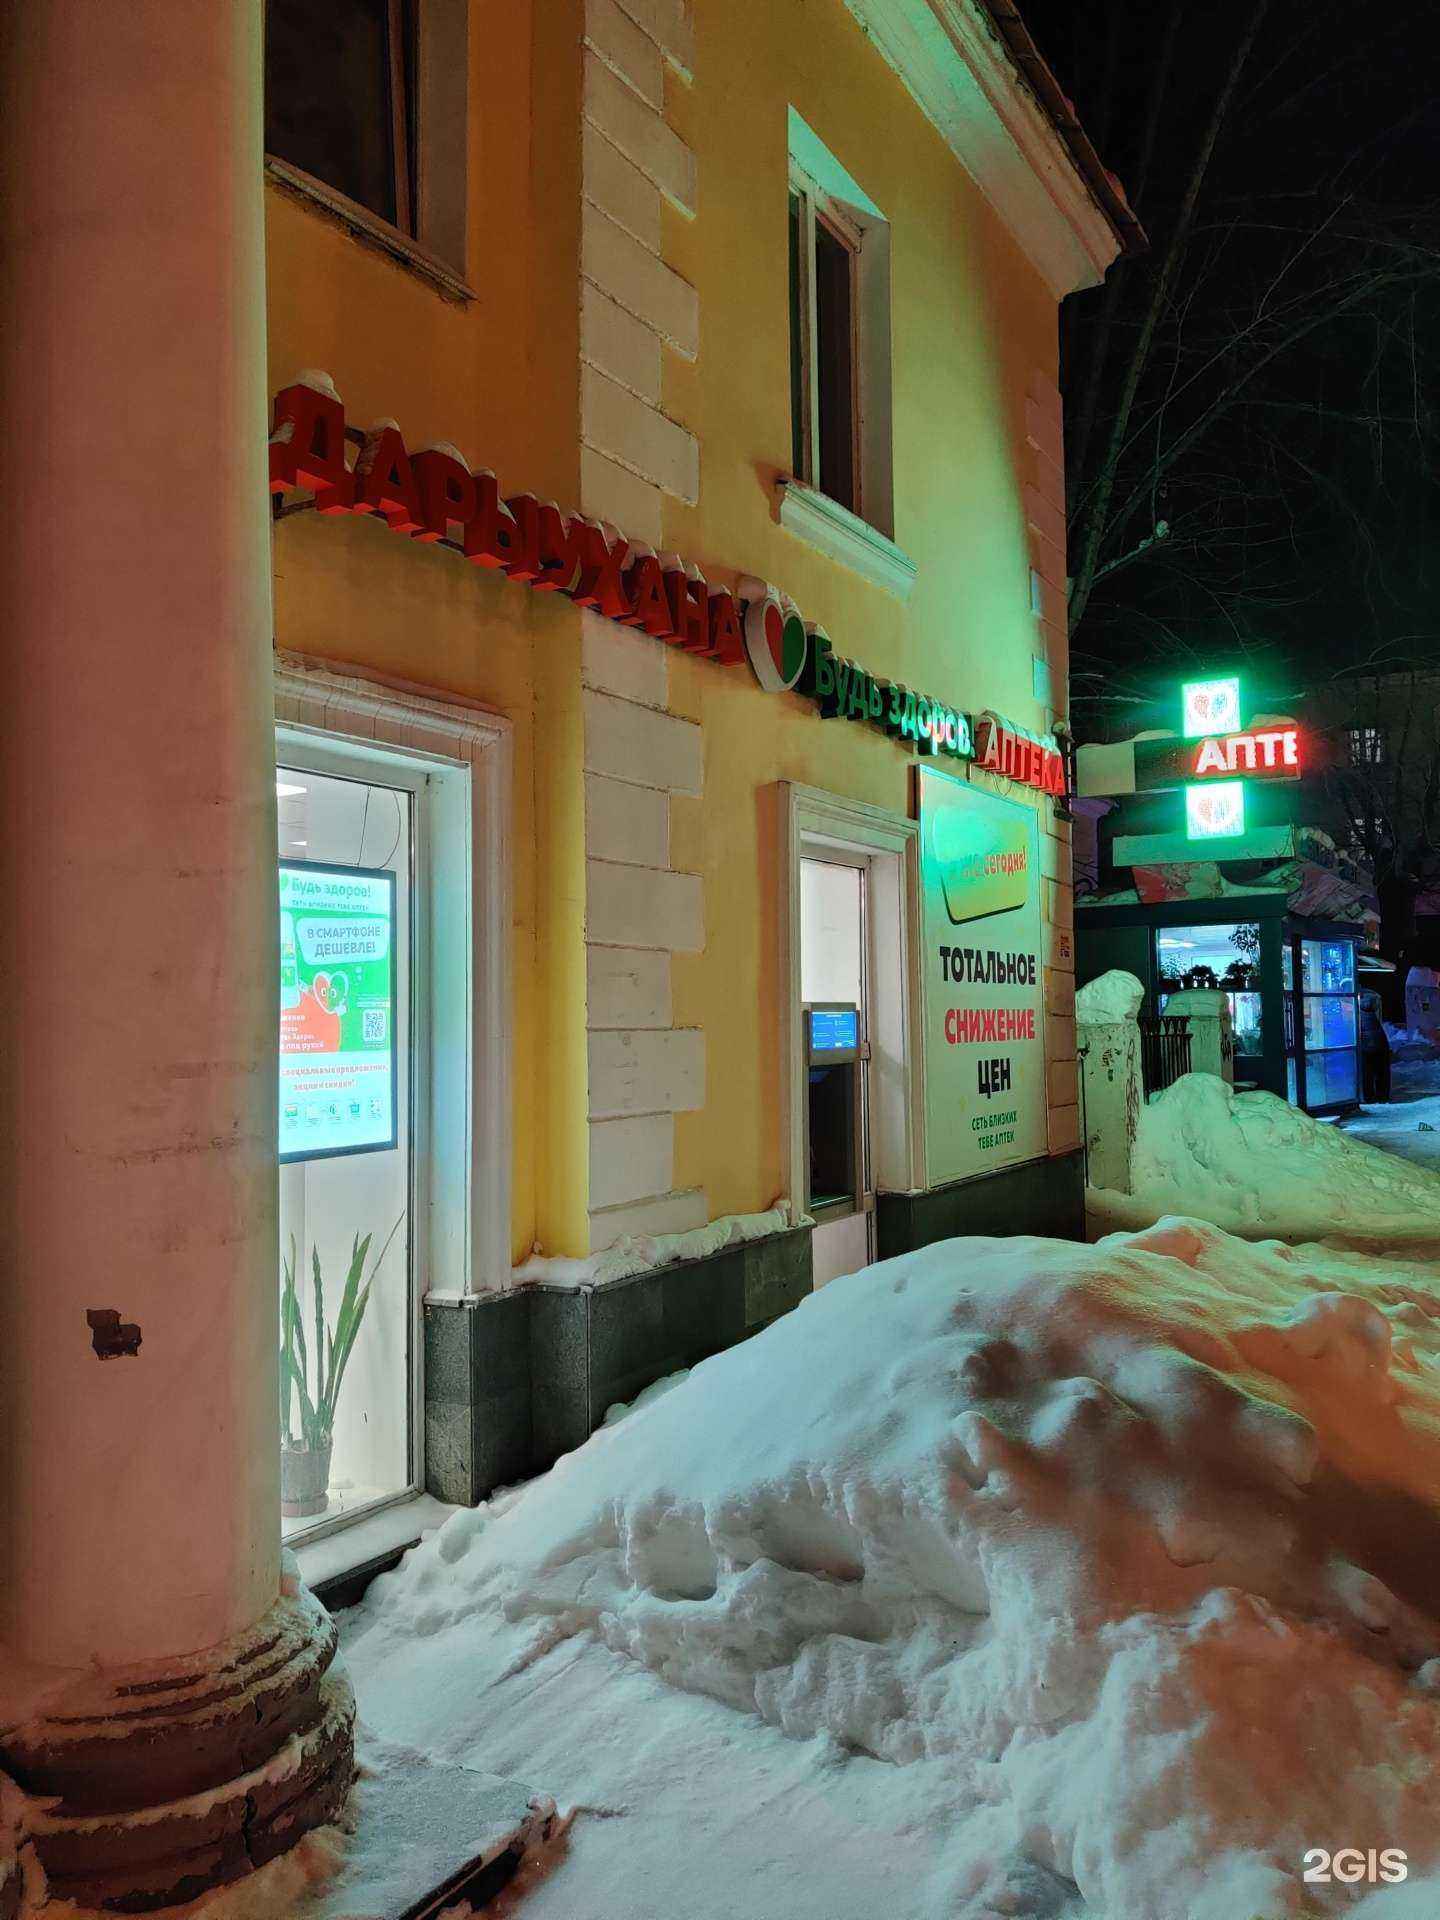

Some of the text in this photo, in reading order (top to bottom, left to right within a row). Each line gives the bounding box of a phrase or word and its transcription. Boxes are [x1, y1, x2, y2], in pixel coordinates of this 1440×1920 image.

[980, 714, 1067, 797] АПТЕКА
[983, 848, 1028, 877] сегодня!
[316, 926, 381, 939] СМАРТФОНЕ
[314, 941, 376, 958] ДЕШЕВЛЕ!
[938, 945, 1036, 986] ТОТАЛЬНОЕ
[944, 1008, 1036, 1045] СНИЖЕНИЕ
[977, 1057, 1012, 1099] ЦЕН
[971, 1110, 1018, 1131] СЕТЬ БЛИЗКИХ
[977, 1130, 1015, 1150] ТЕБЕ АПТЕК
